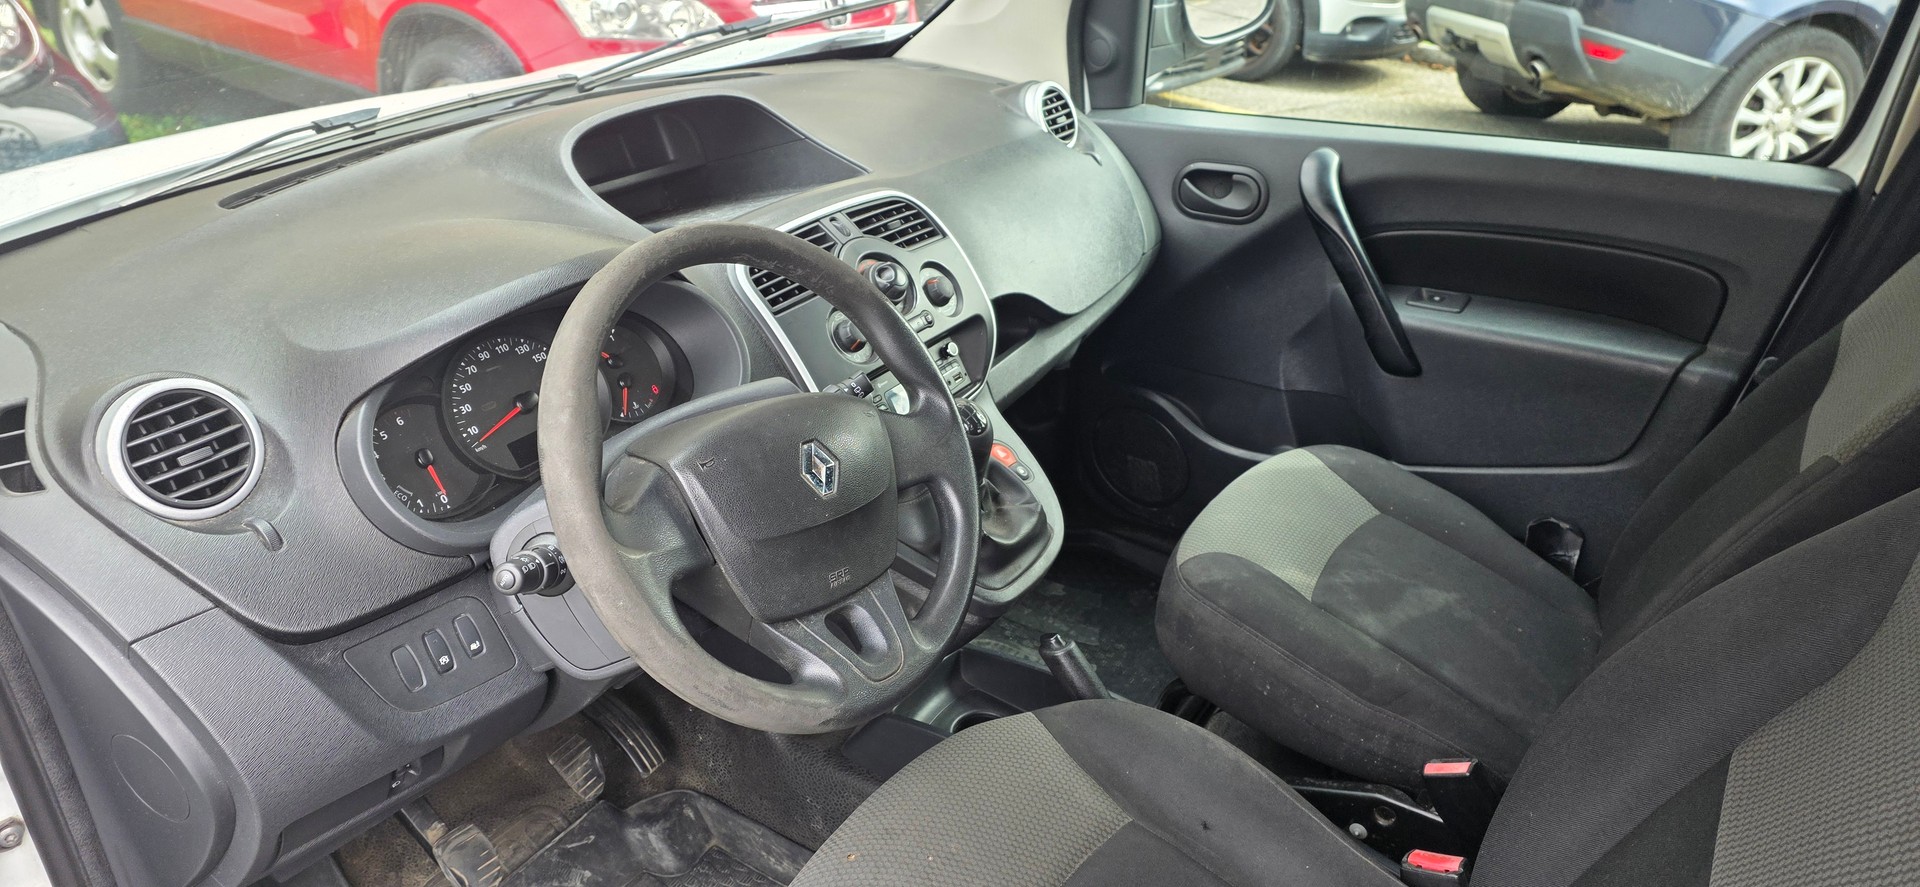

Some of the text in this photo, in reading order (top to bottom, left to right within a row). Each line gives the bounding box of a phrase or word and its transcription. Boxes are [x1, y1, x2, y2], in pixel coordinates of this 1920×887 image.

[495, 343, 509, 354] 110
[515, 344, 530, 355] 130
[478, 350, 490, 361] 90
[532, 352, 547, 363] 150
[465, 365, 478, 375] 70
[459, 383, 472, 394] 50
[459, 404, 472, 415] 30
[396, 416, 404, 426] 6
[379, 430, 388, 440] 5
[467, 425, 479, 436] 10
[474, 444, 487, 453] km/h
[393, 490, 408, 501] ECO
[440, 494, 448, 504] 0
[416, 498, 424, 507] 1
